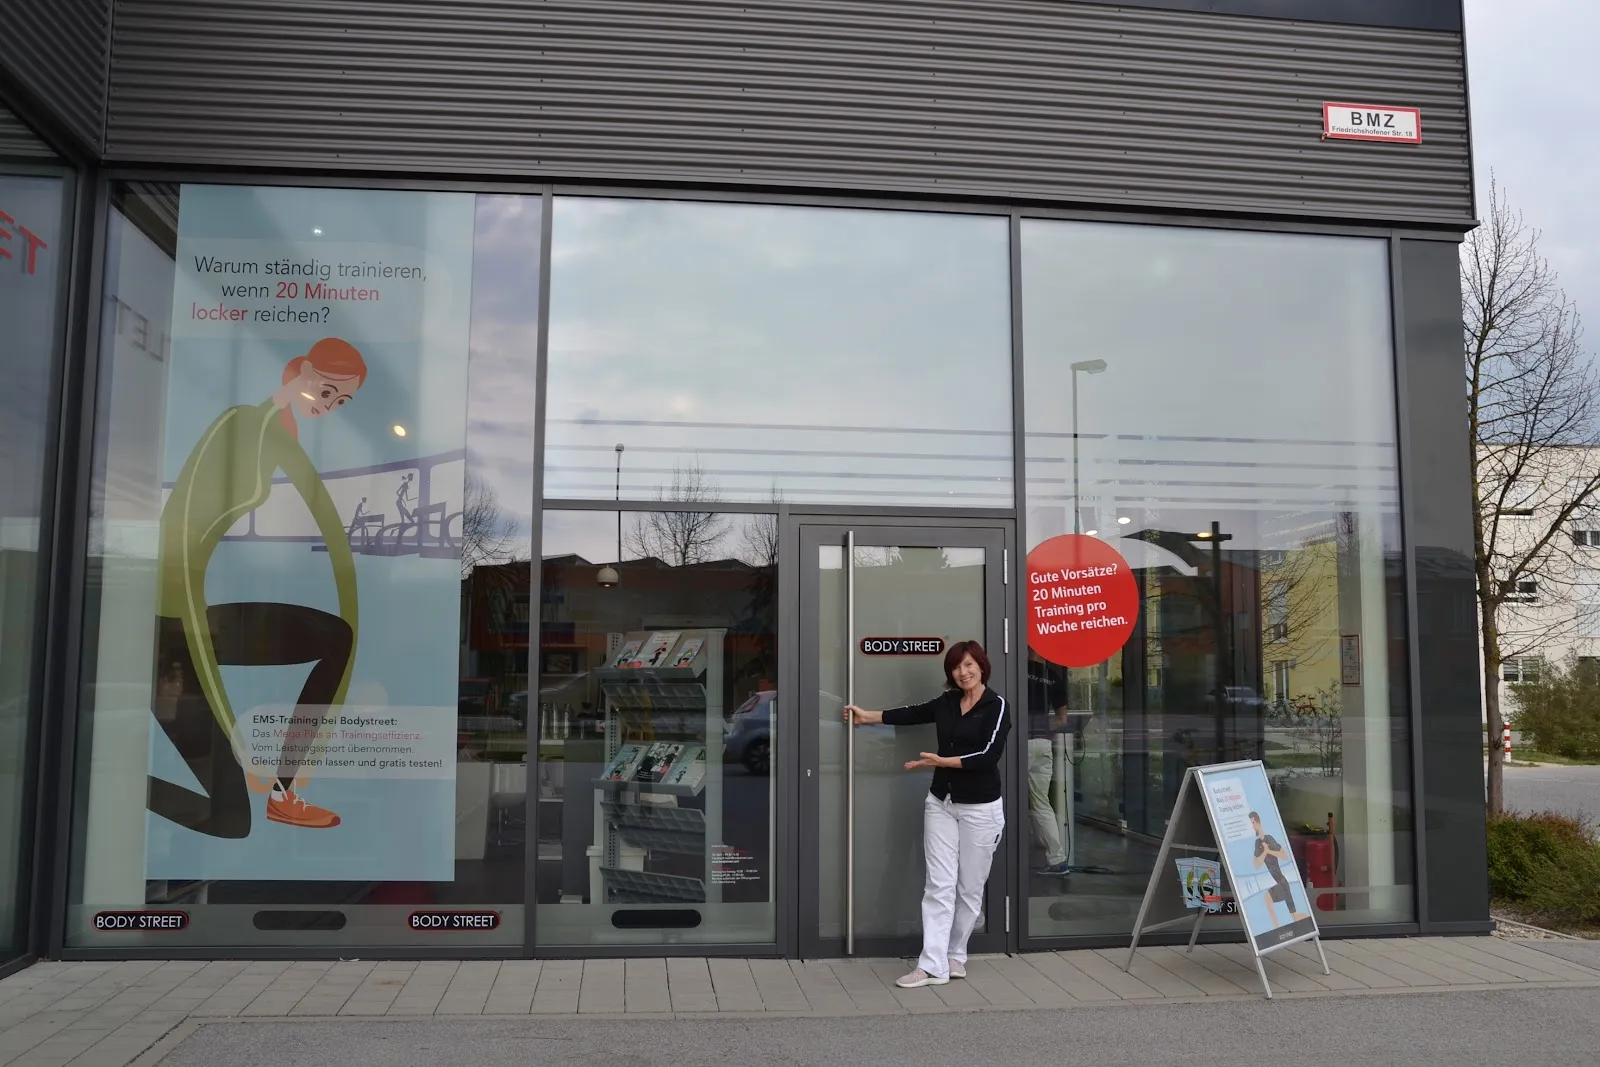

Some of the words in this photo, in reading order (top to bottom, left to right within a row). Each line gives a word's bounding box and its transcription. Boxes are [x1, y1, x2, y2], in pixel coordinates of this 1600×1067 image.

[1351, 111, 1395, 128] BMZ
[1331, 125, 1390, 136] Friedrichshofener
[194, 256, 258, 274] Warum
[264, 259, 331, 281] ständig
[337, 261, 427, 282] trainieren,
[221, 284, 270, 298] wenn
[275, 282, 298, 299] 20
[304, 283, 379, 301] Minuten
[191, 302, 248, 321] locker
[254, 306, 331, 323] reichen?
[1030, 572, 1059, 584] Gute
[1061, 563, 1118, 581] Vorsätze?
[1032, 588, 1049, 602] 20
[1051, 584, 1102, 599] Minuten
[1034, 603, 1084, 618] Training
[1086, 601, 1107, 615] pro
[1036, 620, 1078, 635] Woche
[1081, 615, 1128, 630] reichen.
[864, 640, 899, 652] BODY
[902, 640, 941, 652] STREET
[252, 715, 318, 727] EMS-Training
[321, 716, 337, 725] bei
[340, 716, 398, 728] Bodystreet:
[252, 728, 271, 738] Das
[273, 729, 324, 741] Mega-Plus
[327, 731, 338, 739] an
[340, 730, 423, 741] Trainingseffizienz.
[251, 743, 273, 752] Vom
[275, 743, 346, 754] Leistungssport
[348, 744, 415, 754] übernommen.
[251, 756, 282, 767] Gleich
[284, 757, 323, 767] beraten
[325, 757, 355, 767] lassen
[358, 758, 376, 767] und
[379, 758, 406, 769] gratis
[409, 759, 443, 768] testen!
[96, 915, 136, 928] BODY
[139, 915, 183, 928] STREET
[412, 915, 450, 927] BODY
[452, 915, 495, 927] STREET
